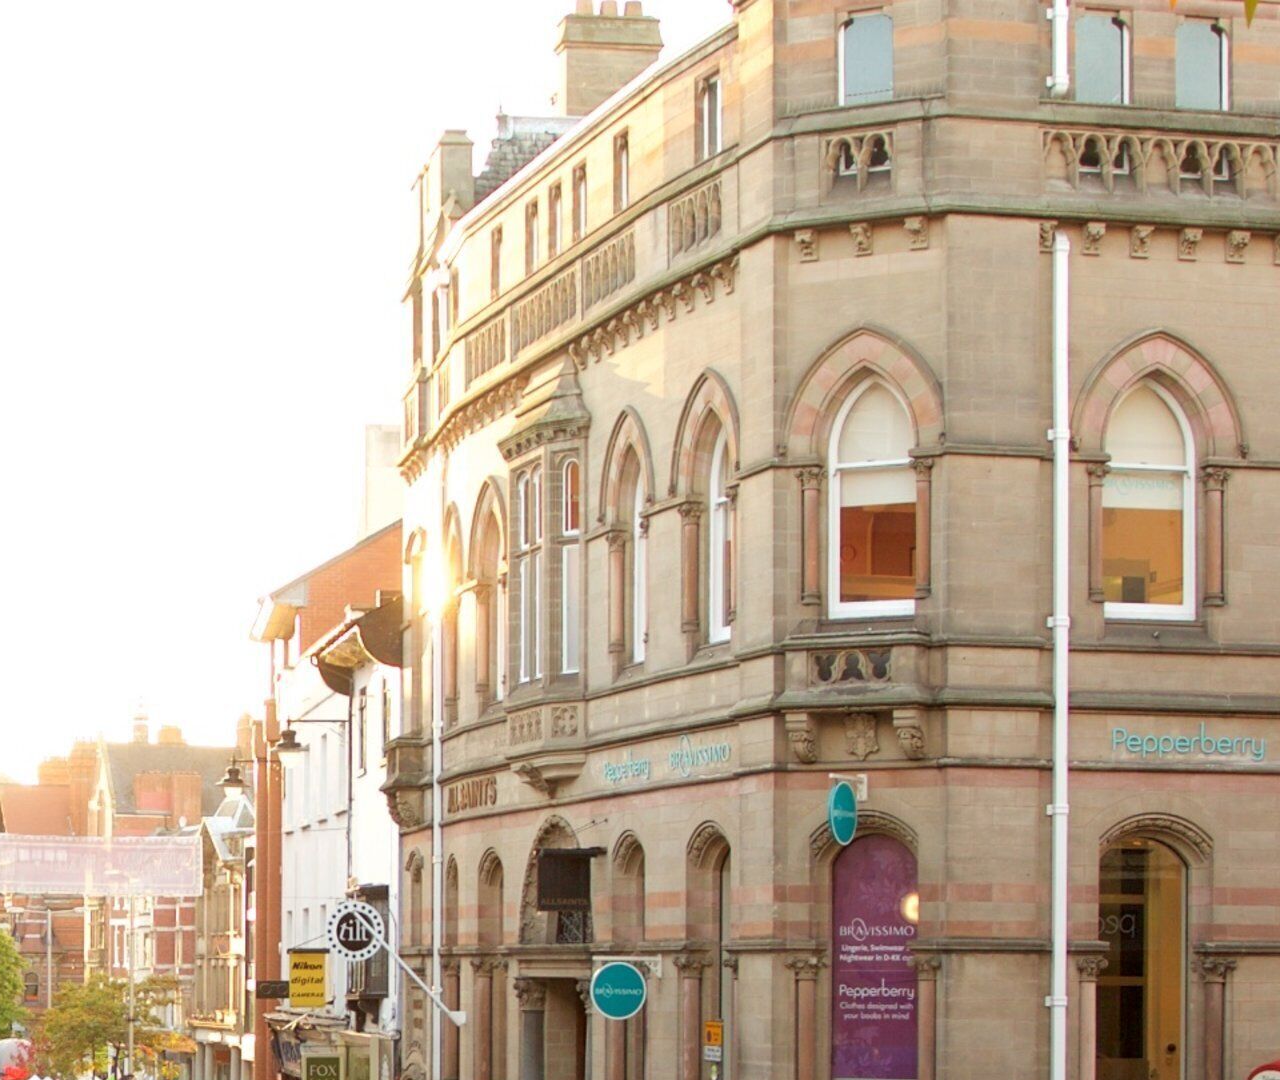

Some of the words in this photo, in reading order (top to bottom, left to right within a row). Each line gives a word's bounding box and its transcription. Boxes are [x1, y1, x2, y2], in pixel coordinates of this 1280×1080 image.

[1112, 722, 1265, 761] Pepperberry
[669, 735, 731, 778] BRAVISSIMO
[603, 751, 651, 784] Pepperberry
[338, 918, 370, 942] tilt
[839, 918, 915, 941] BRAVISSIMO
[292, 961, 323, 971] Nikon
[839, 954, 874, 963] Nightwear
[291, 976, 324, 986] digital
[839, 978, 915, 1000] Pepperberry
[594, 982, 643, 998] BRAVISSIMO
[839, 1001, 865, 1010] Clothes
[867, 1002, 898, 1011] designed
[900, 1002, 914, 1010] with
[843, 1012, 859, 1021] your
[883, 1012, 890, 1020] in
[891, 1011, 910, 1020] mind
[309, 1064, 337, 1077] FOX
